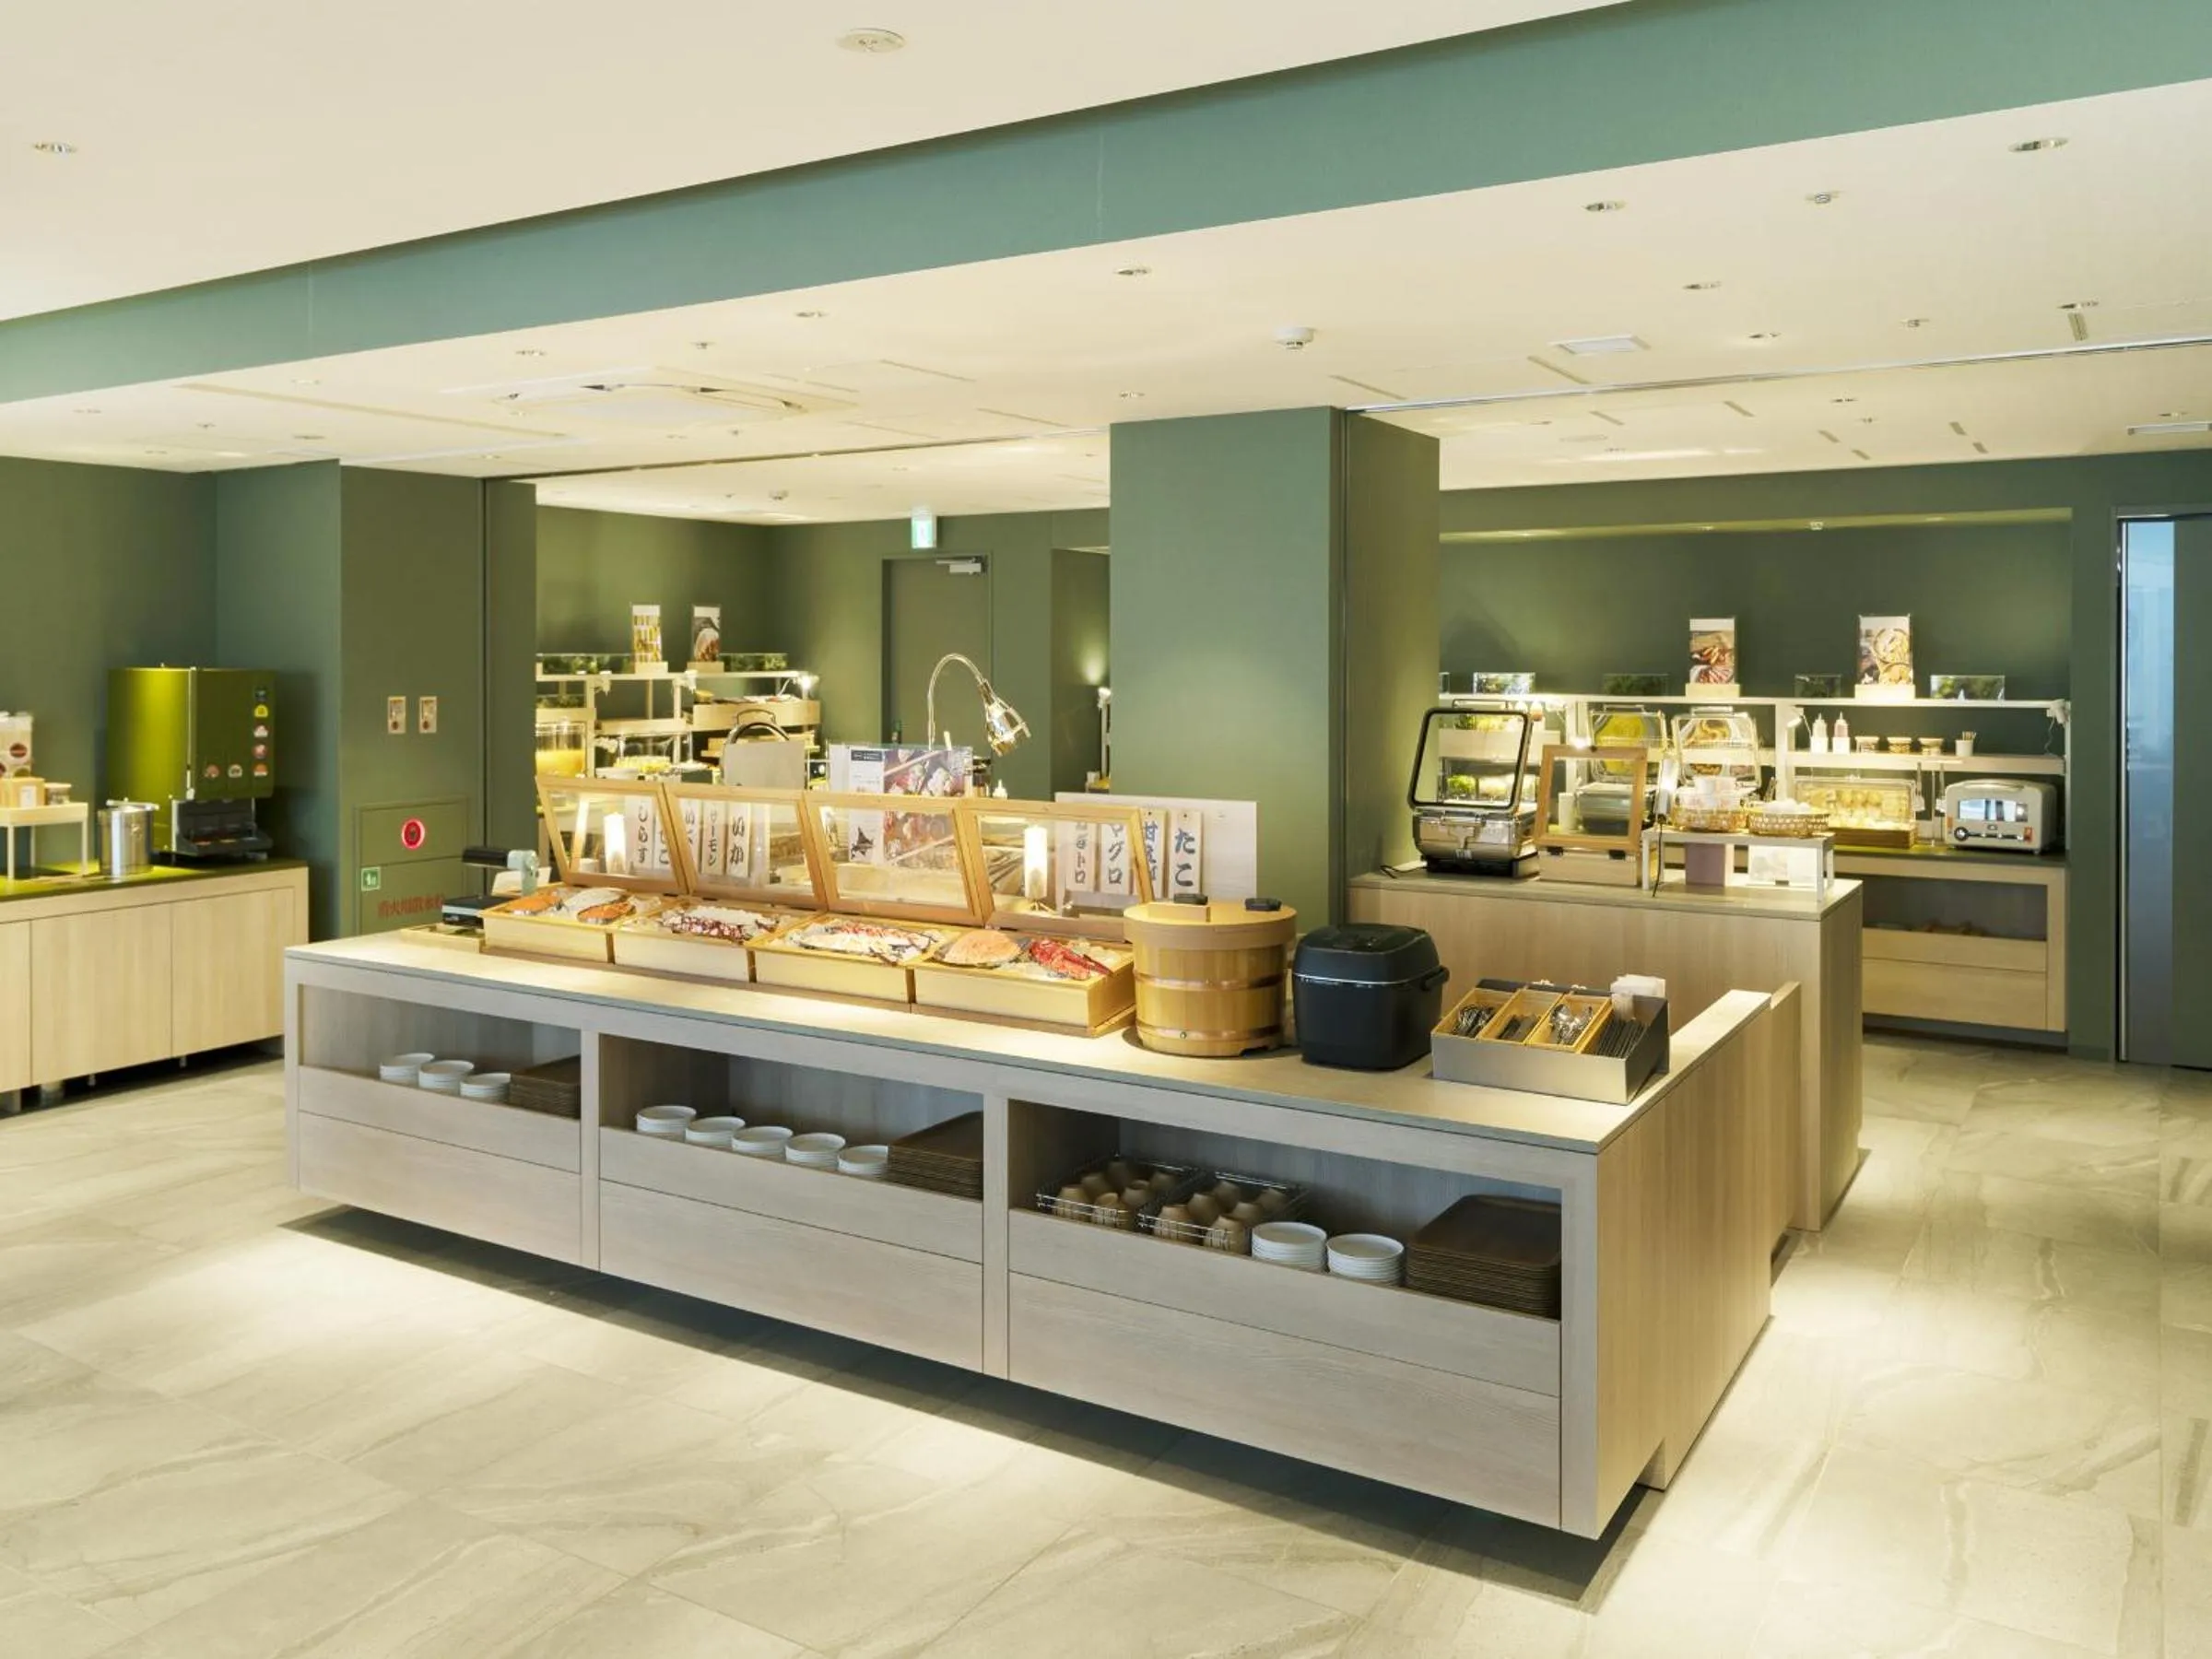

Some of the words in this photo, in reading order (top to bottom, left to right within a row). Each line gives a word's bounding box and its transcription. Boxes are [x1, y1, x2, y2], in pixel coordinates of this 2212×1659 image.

[707, 809, 718, 867] サーモン
[730, 817, 745, 865] いか
[1109, 824, 1124, 885] マグロ
[1174, 828, 1195, 887] たこ
